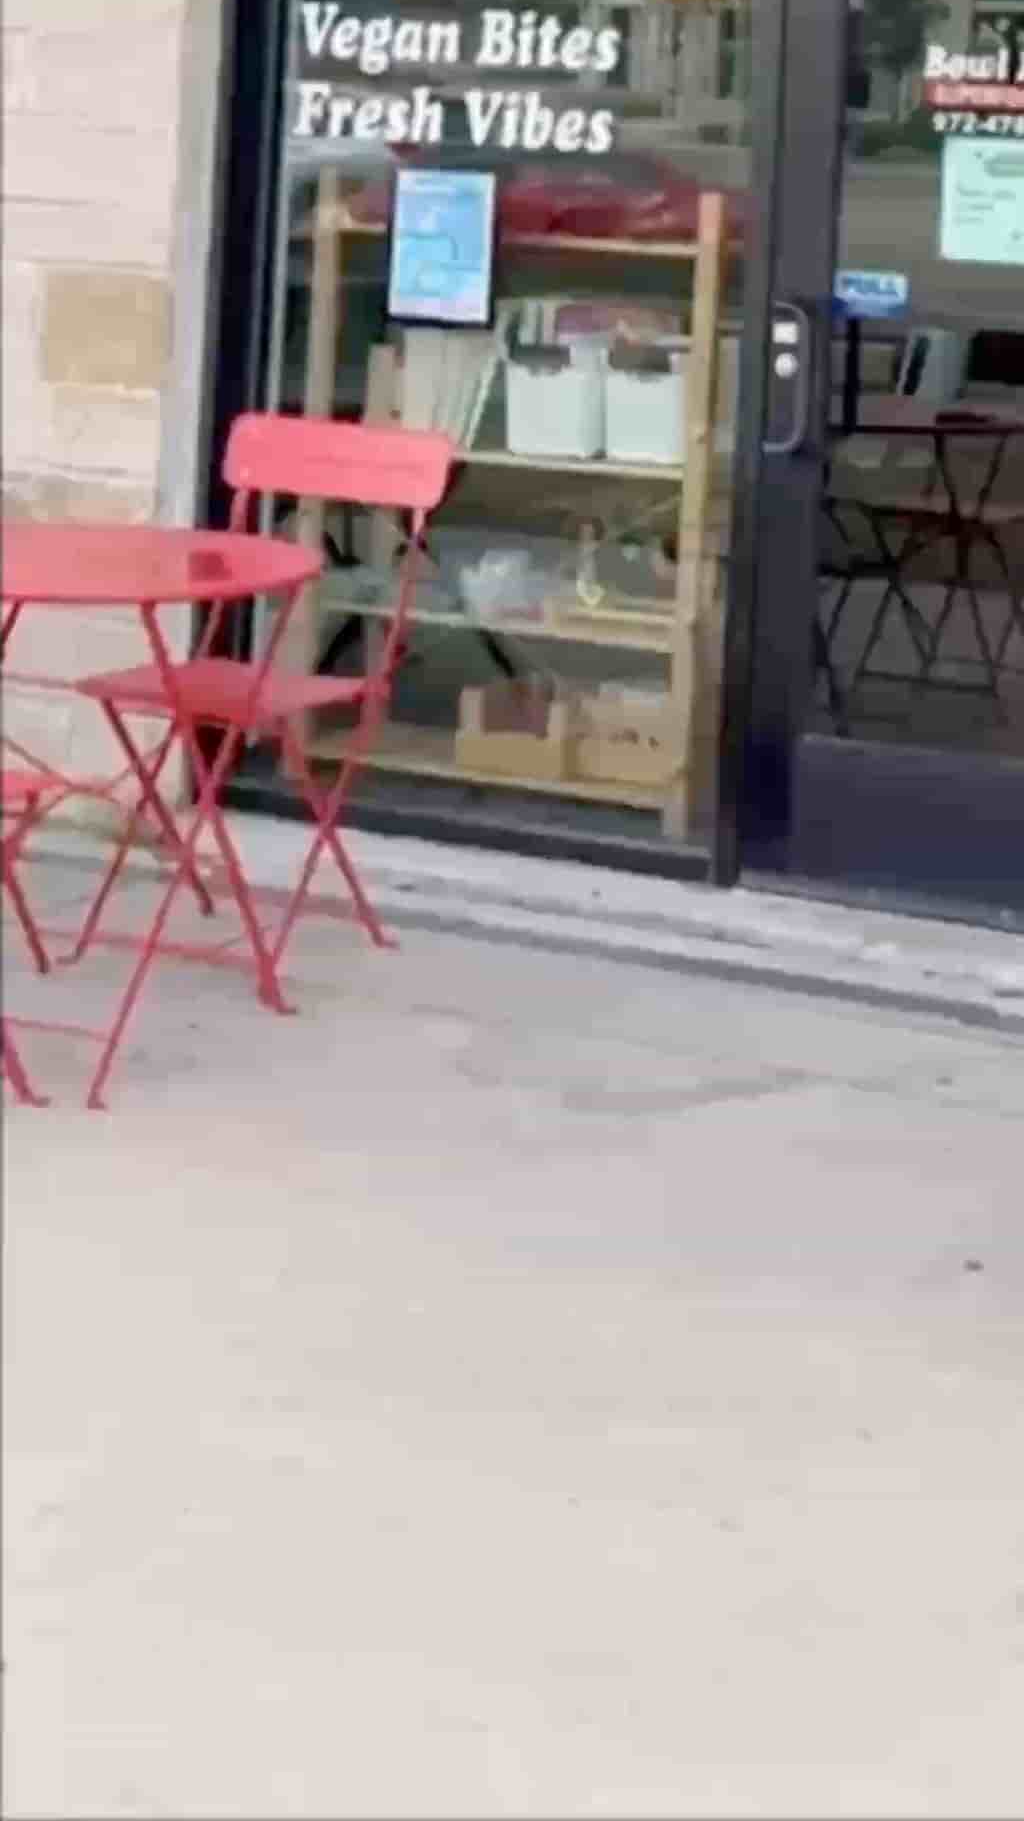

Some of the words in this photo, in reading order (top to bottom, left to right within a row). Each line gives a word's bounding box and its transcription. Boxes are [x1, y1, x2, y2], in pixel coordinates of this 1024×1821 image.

[300, 1, 460, 75] Vegan
[474, 9, 622, 72] Bites
[923, 43, 1010, 81] Bowl
[291, 81, 443, 143] Fresh
[463, 88, 615, 153] Vibes
